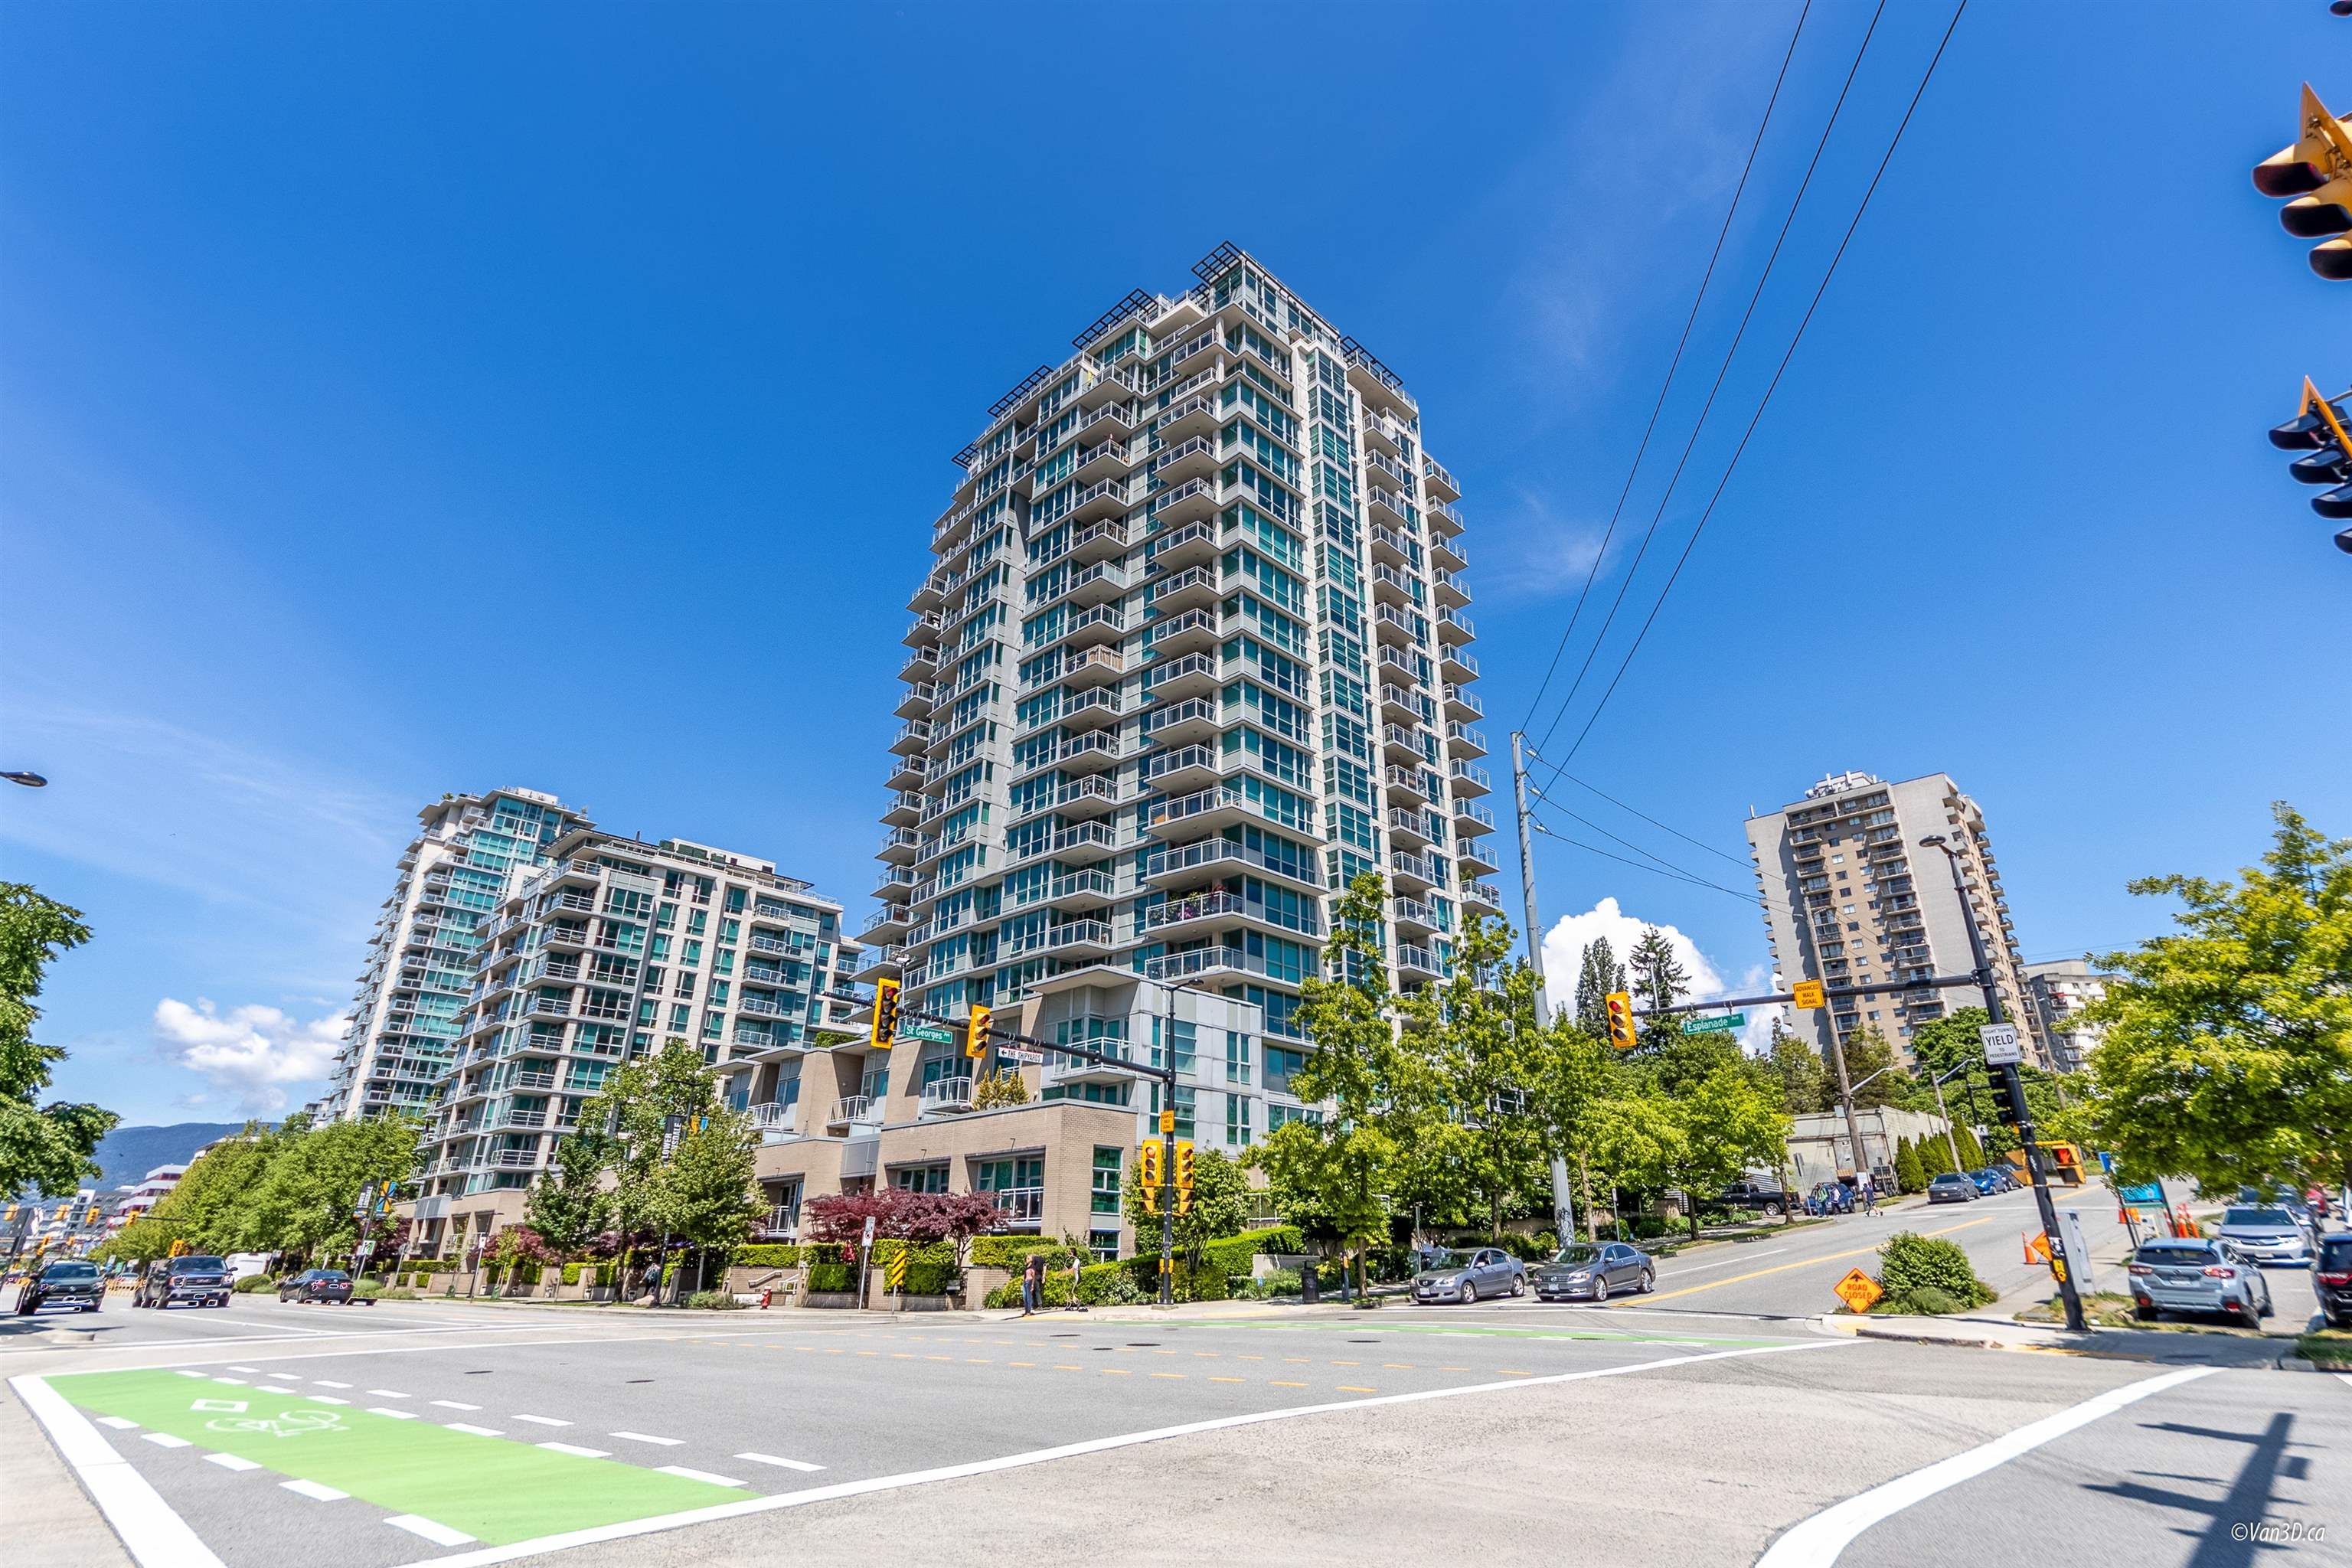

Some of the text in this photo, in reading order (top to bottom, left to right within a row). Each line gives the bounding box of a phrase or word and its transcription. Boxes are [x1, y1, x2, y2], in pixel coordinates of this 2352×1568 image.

[1686, 1018, 1728, 1032] Esplanade
[906, 1025, 914, 1035] St
[916, 1027, 942, 1040] Georges
[1985, 1034, 2014, 1047] YIELD
[1008, 1050, 1041, 1063] THE SHIPYARDS
[662, 1133, 673, 1158] LOWER
[1844, 1291, 1872, 1299] CLOSED
